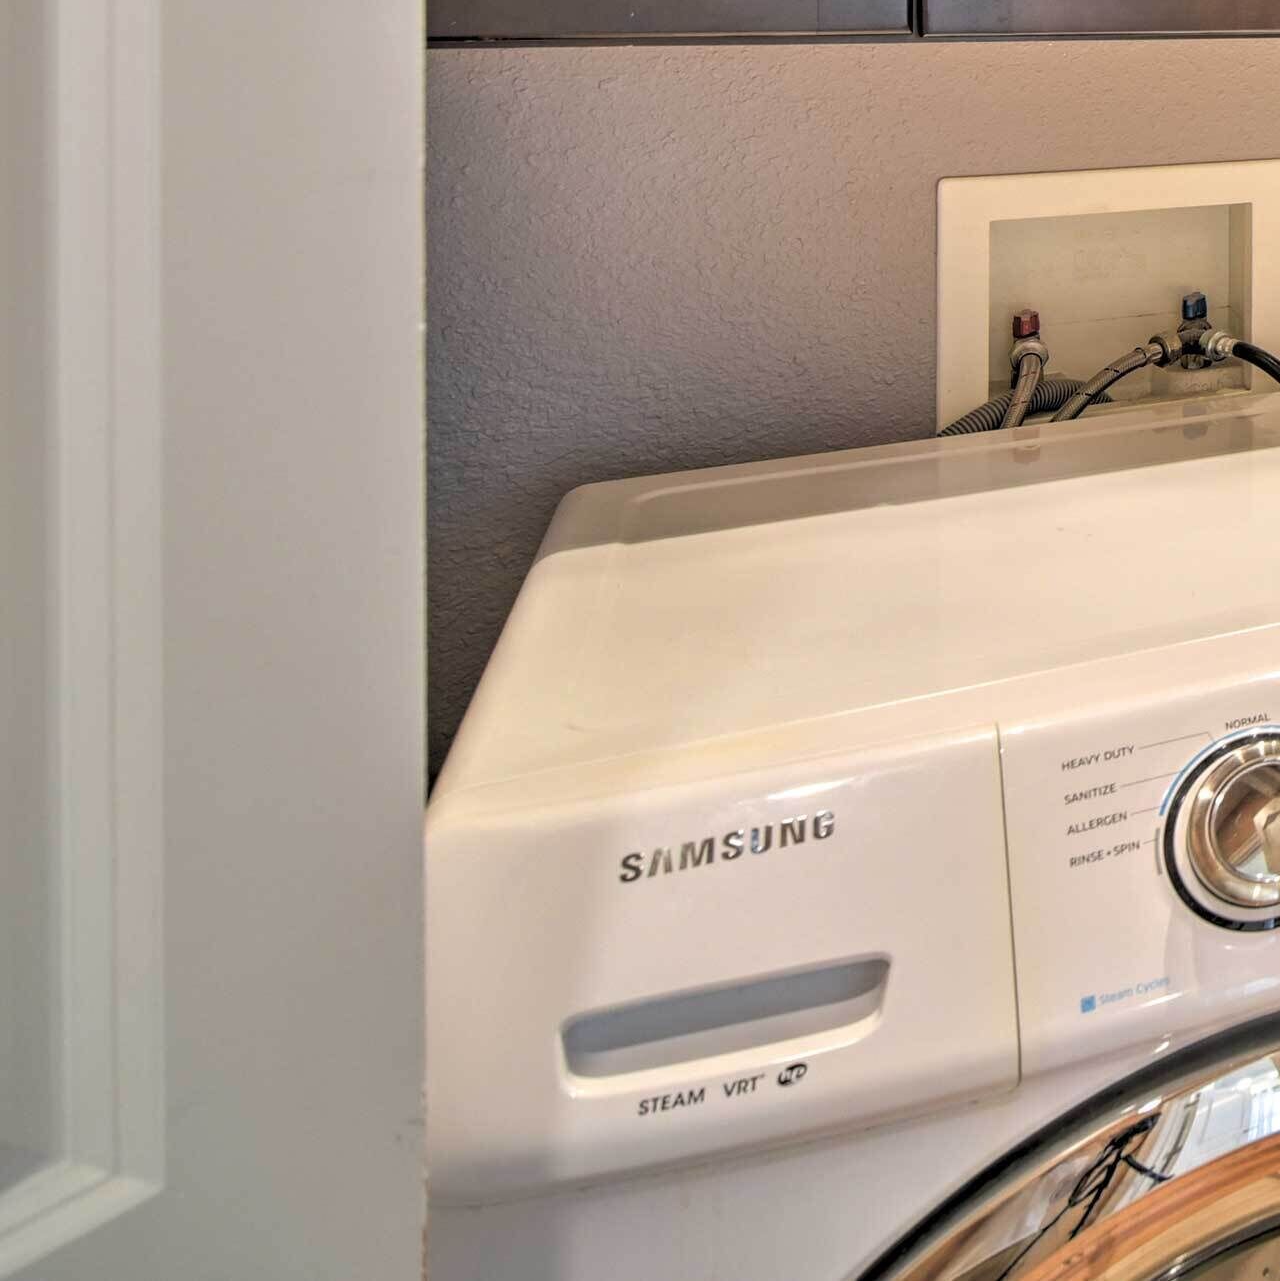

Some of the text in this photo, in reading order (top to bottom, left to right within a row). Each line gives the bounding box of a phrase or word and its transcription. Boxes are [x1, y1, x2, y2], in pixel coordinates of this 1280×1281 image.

[1225, 713, 1270, 731] NORMAL
[1061, 746, 1134, 771] HEAVY DUTY
[1064, 783, 1117, 805] SANITIZE
[1067, 811, 1127, 835] ALLERGEN
[619, 809, 835, 883] SAMSUNG
[638, 1087, 705, 1116] STEAM
